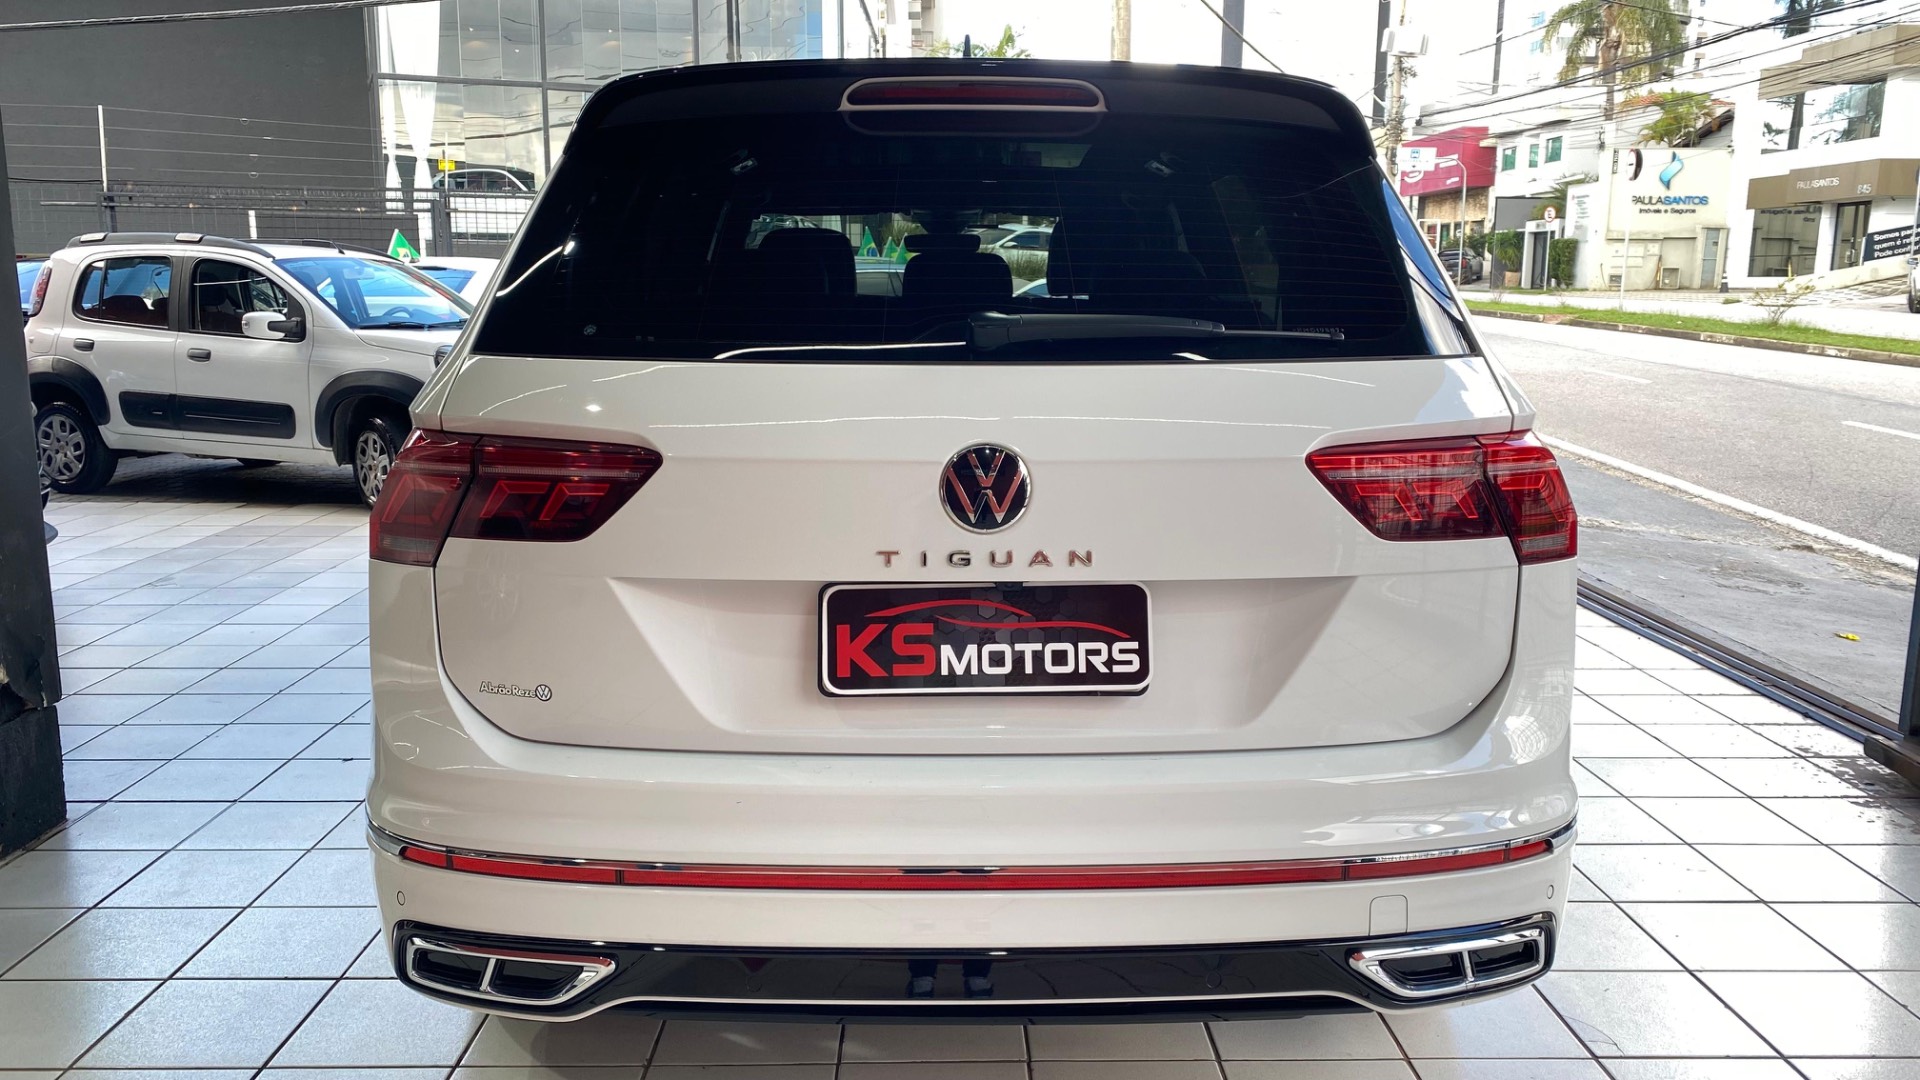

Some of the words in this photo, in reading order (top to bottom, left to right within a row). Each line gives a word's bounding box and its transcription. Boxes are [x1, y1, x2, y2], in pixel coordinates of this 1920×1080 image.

[1670, 207, 1697, 215] Seguros
[1873, 232, 1899, 242] Somos
[1874, 241, 1895, 251] quem
[1874, 249, 1893, 259] Pode
[876, 549, 1095, 569] TIGUAN
